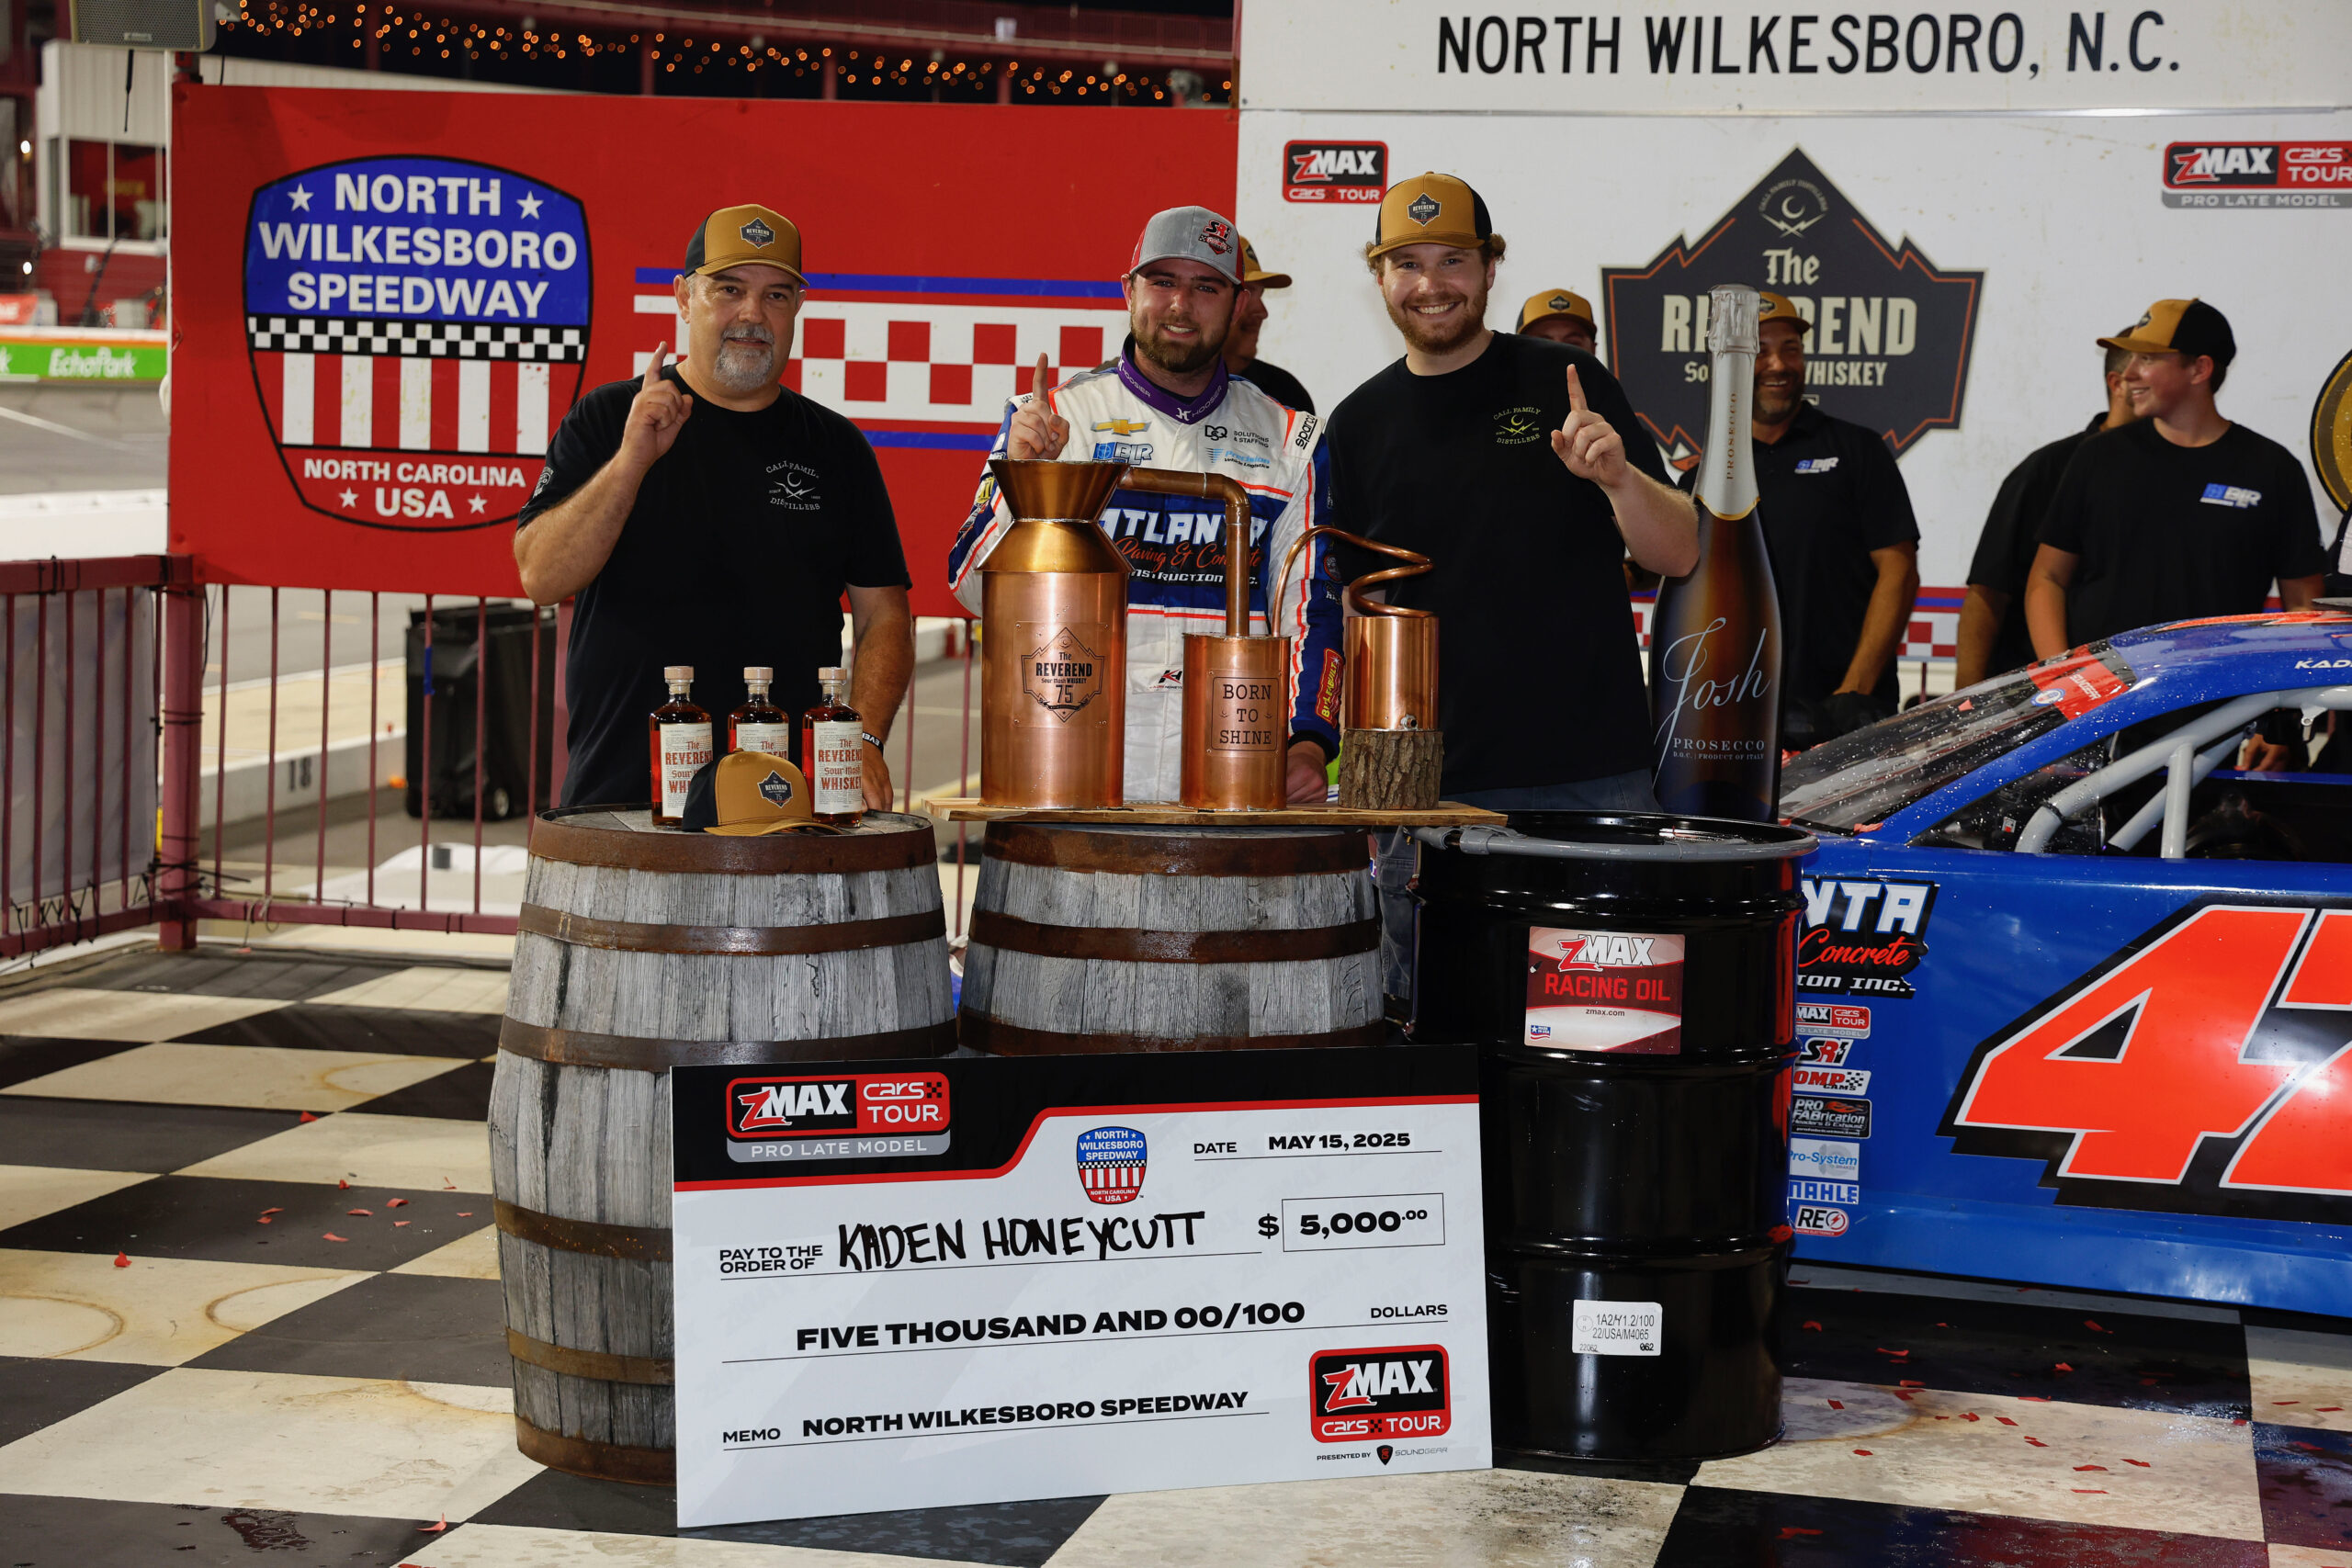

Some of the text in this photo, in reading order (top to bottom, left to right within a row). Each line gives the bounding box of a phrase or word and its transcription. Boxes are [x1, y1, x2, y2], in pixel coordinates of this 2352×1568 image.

[1438, 11, 2179, 79] NORTH WILKESBORO, N.C.
[2287, 166, 2352, 182] TOUR
[335, 173, 502, 217] NORTH
[1338, 188, 1380, 200] TOUR
[2181, 195, 2340, 207] PRO LATE MODEL
[258, 222, 578, 272] WILKESBORO
[1762, 246, 1820, 286] The
[287, 272, 548, 319] SPEEDWAY
[1661, 295, 1917, 355] RREND
[49, 346, 137, 378] EchoPark
[1493, 407, 1542, 421] CALL FAMILY
[1234, 431, 1270, 443] SOLUTIONS
[1295, 413, 1317, 449] sparco
[1239, 437, 1270, 448] STAFFING
[1497, 433, 1541, 445] DISTILLERS
[303, 457, 391, 483] NORTH
[396, 462, 526, 488] CAROLINA
[766, 460, 820, 479] CALL FAMIL
[374, 488, 454, 520] USA
[1099, 507, 1270, 547] ATLANA
[1196, 543, 1263, 569] Conte
[1131, 568, 1224, 583] NSTRUCTION
[1058, 651, 1072, 660] The
[1035, 662, 1092, 677] REVEREND
[2294, 660, 2352, 669] KAD
[1056, 684, 1073, 704] 75
[1223, 684, 1272, 700] BORN
[1652, 616, 1772, 788] Josh
[1237, 708, 1259, 722] TO
[687, 740, 700, 750] The
[761, 740, 774, 750] The
[840, 739, 853, 748] The
[1219, 730, 1272, 745] SHINE
[1673, 737, 1765, 750] PROSECCO
[1699, 752, 1734, 761] PRODUCT
[1735, 752, 1745, 761] OF
[1747, 752, 1765, 761] ITALY
[672, 770, 691, 779] Sour
[824, 766, 843, 775] Sour
[820, 776, 862, 791] WHISKE
[1798, 928, 1918, 968] Concrete
[1544, 973, 1670, 1001] RACING OIL
[1849, 977, 1906, 992] INC.
[1586, 1008, 1625, 1017] zmax.com
[1796, 1007, 1828, 1021] MAX
[1836, 1018, 1866, 1026] TOUR
[1793, 1070, 1846, 1086] OMP
[1823, 1083, 1857, 1091] CAMS
[1795, 1099, 1825, 1111] PRO
[867, 1104, 939, 1124] TOUR
[1792, 1110, 1866, 1124] FABrication
[1094, 1131, 1129, 1140] NORTH
[751, 1139, 927, 1158] PRO LATE MODEL
[1080, 1141, 1144, 1151] WILKESBORO
[1194, 1133, 1411, 1155] DATE MAY 15, 2025
[1086, 1150, 1138, 1161] SPEEDWAY
[1790, 1150, 1858, 1168] Pro-System
[1258, 1213, 1280, 1238] $
[838, 1212, 1205, 1271] KADEN HONEYCUTT
[719, 1245, 823, 1261] PAY TO THE
[719, 1258, 815, 1274] ORDER OF
[797, 1302, 1448, 1350] FIVE THOUSAND AND 00/100 DOLLARS
[1592, 1327, 1649, 1340] 22/USA/M4065
[723, 1392, 1248, 1443] MEMO NORTH WILKESBORO SPEEDWAY
[1386, 1416, 1442, 1432] TOUR
[1317, 1453, 1360, 1461] PRESENTED
[1395, 1447, 1448, 1457] SOUNDGEAR
